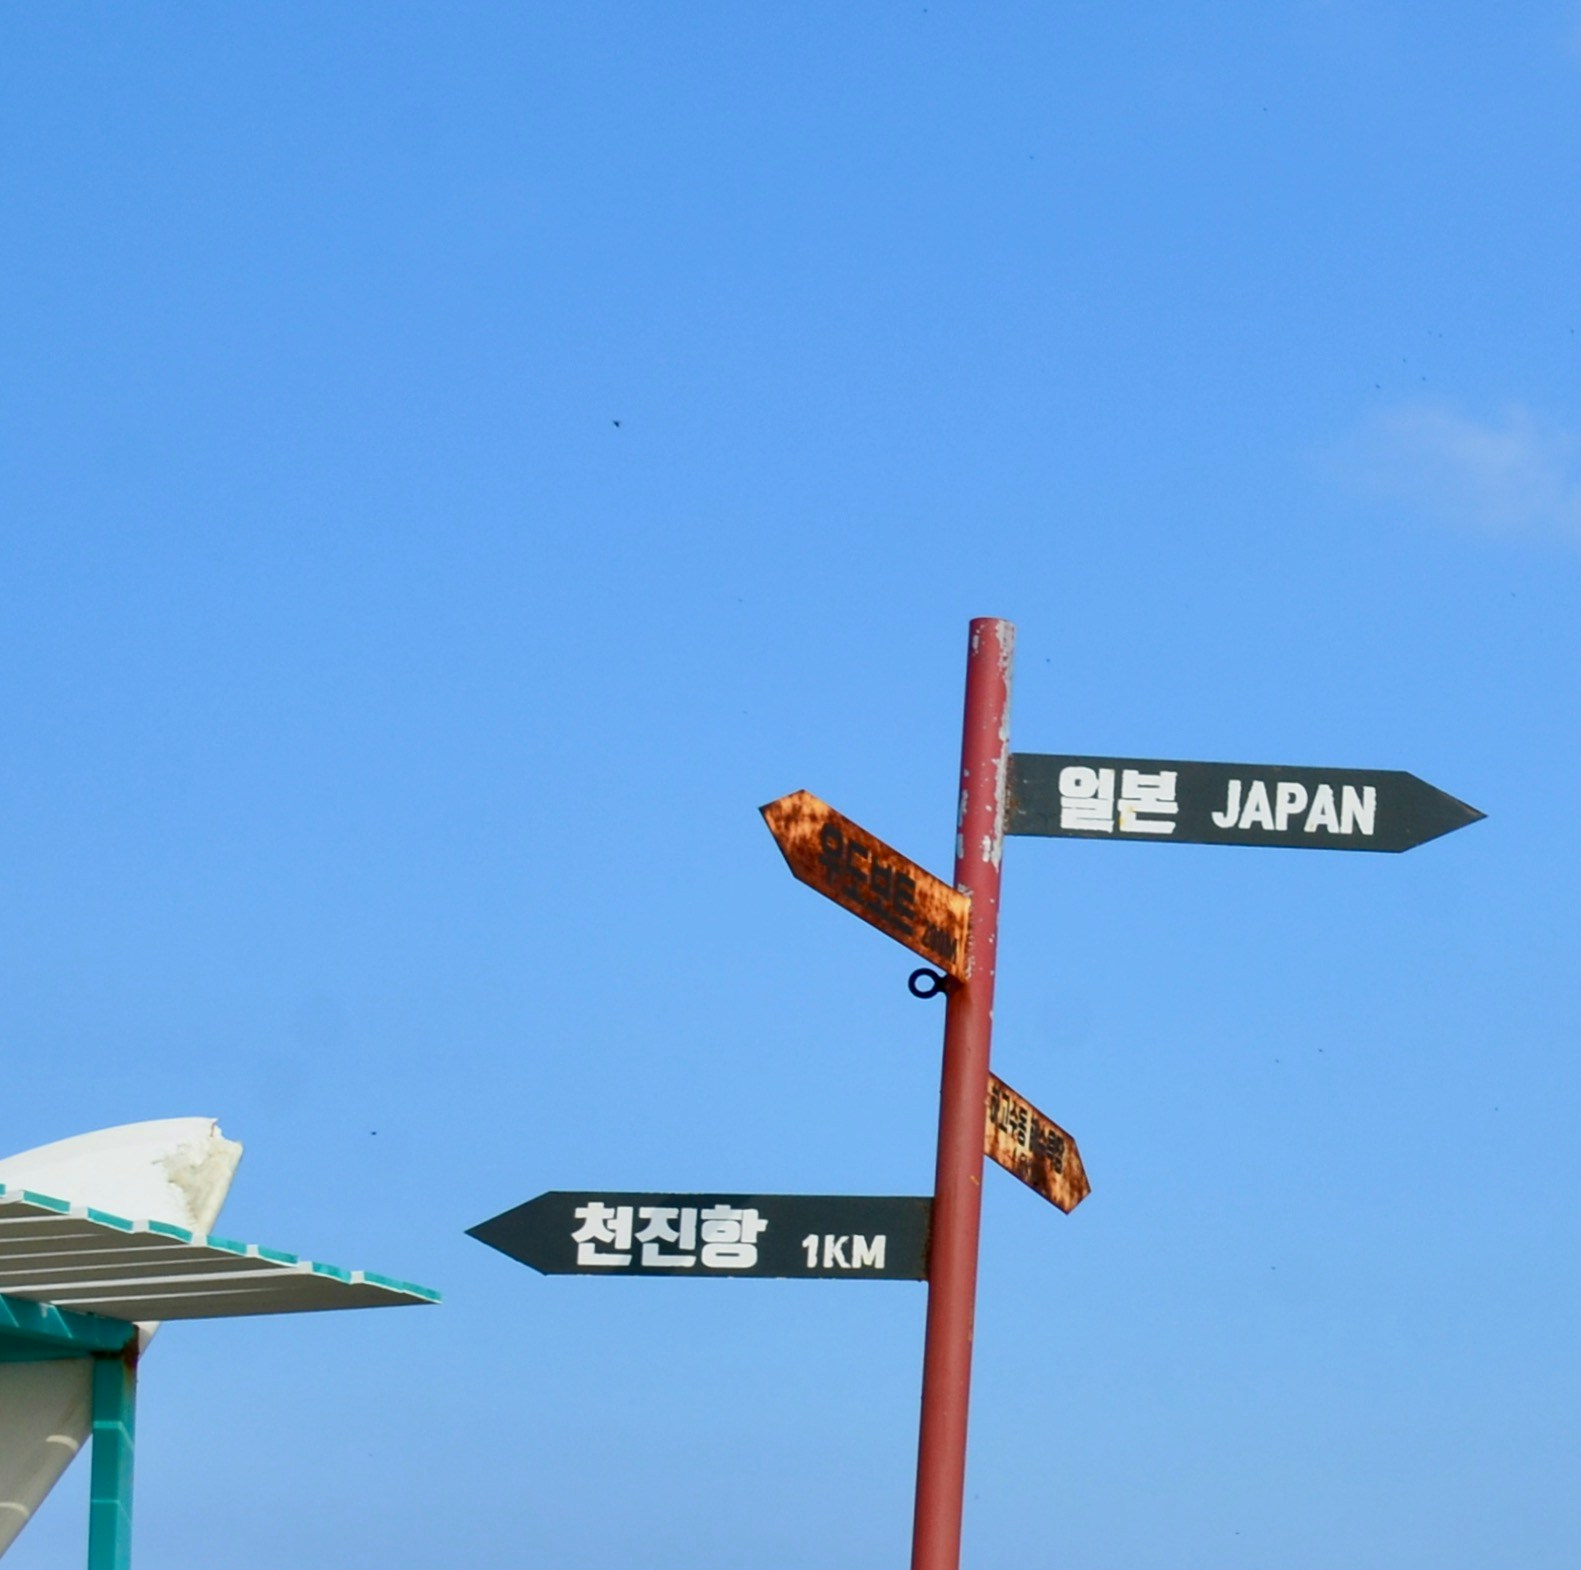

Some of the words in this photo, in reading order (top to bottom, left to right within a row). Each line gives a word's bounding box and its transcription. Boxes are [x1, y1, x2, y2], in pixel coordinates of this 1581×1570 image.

[1058, 766, 1179, 834] 일본
[1211, 779, 1377, 836] JAPAN
[571, 1201, 768, 1269] 천진항
[802, 1234, 886, 1269] 1KM
